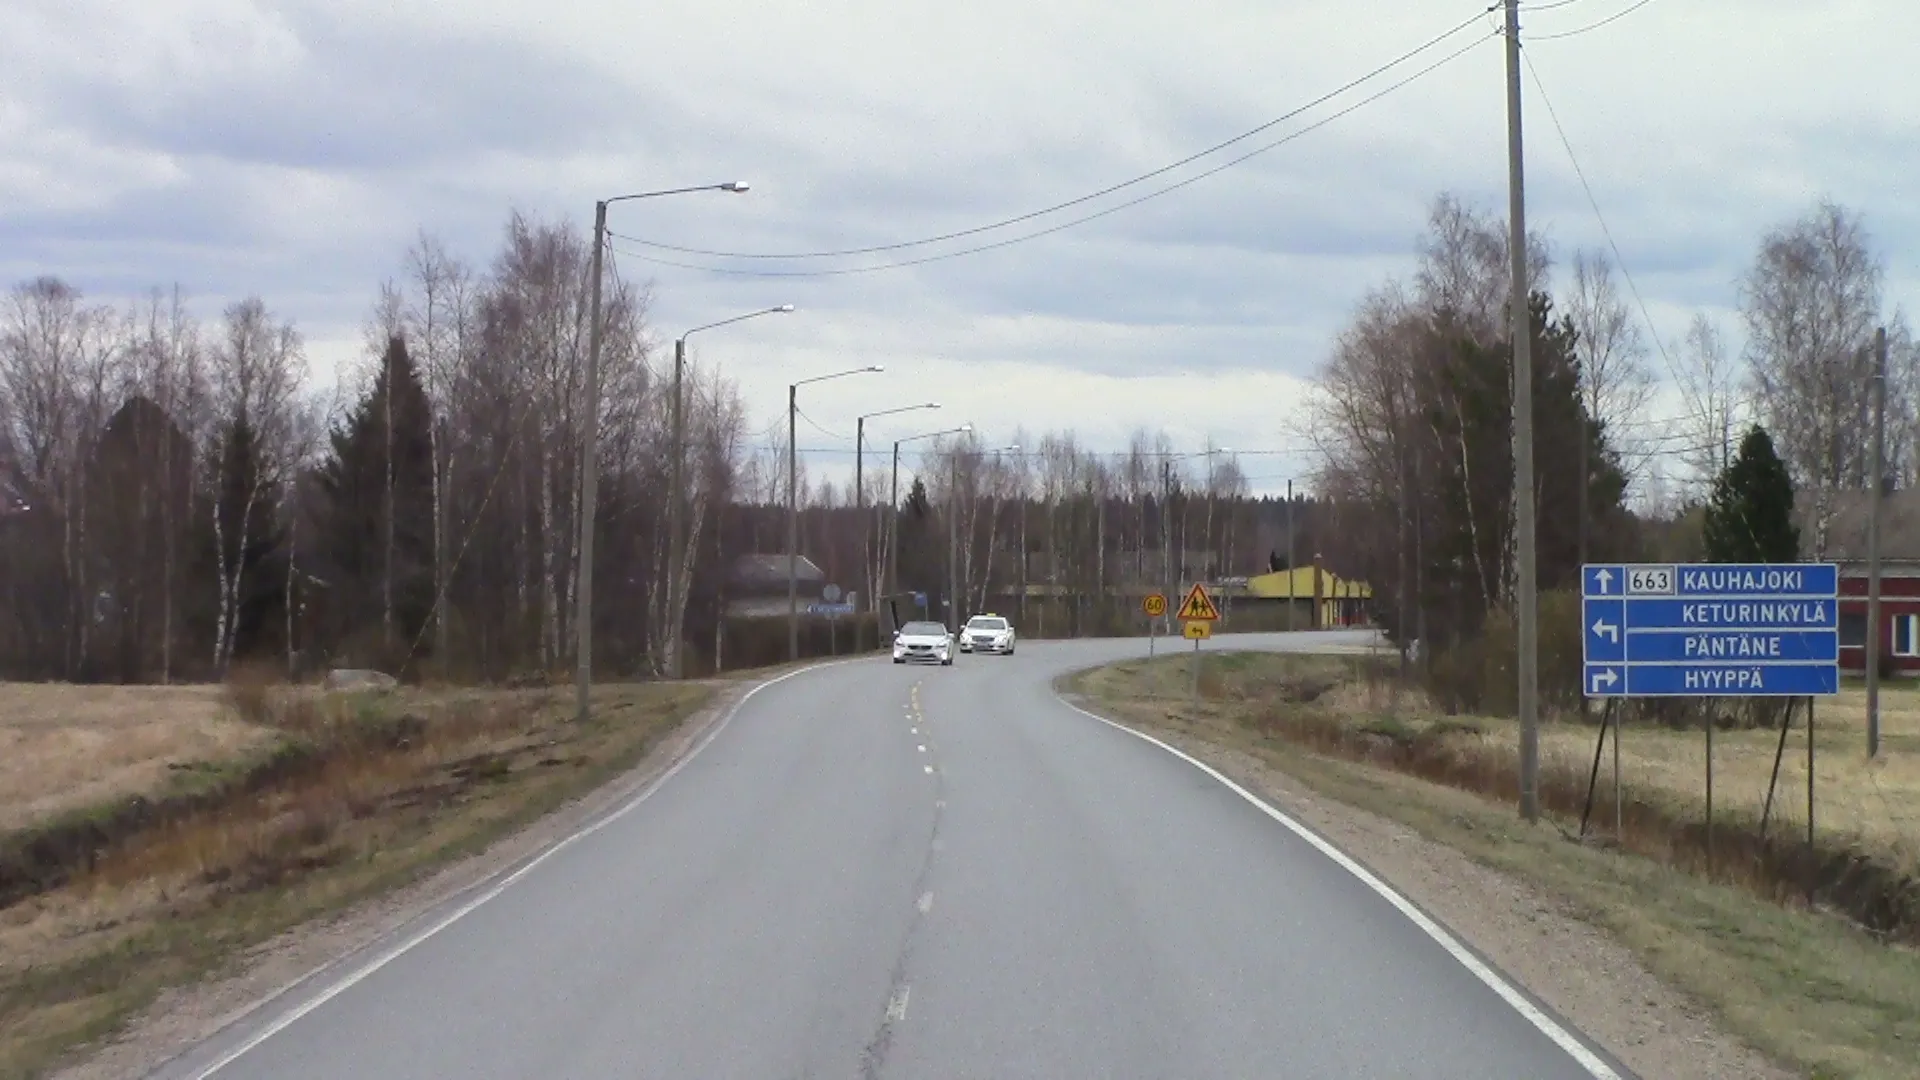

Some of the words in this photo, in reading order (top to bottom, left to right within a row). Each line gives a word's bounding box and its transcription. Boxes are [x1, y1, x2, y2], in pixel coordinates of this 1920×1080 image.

[1632, 572, 1668, 590] 663
[1684, 571, 1802, 590] KAUHAJOKI
[1147, 599, 1162, 609] 60
[1683, 601, 1826, 623] KETURINKYLÄ
[1685, 634, 1781, 656] PÄNTÄNE
[1685, 668, 1763, 688] HYYPPÄ
